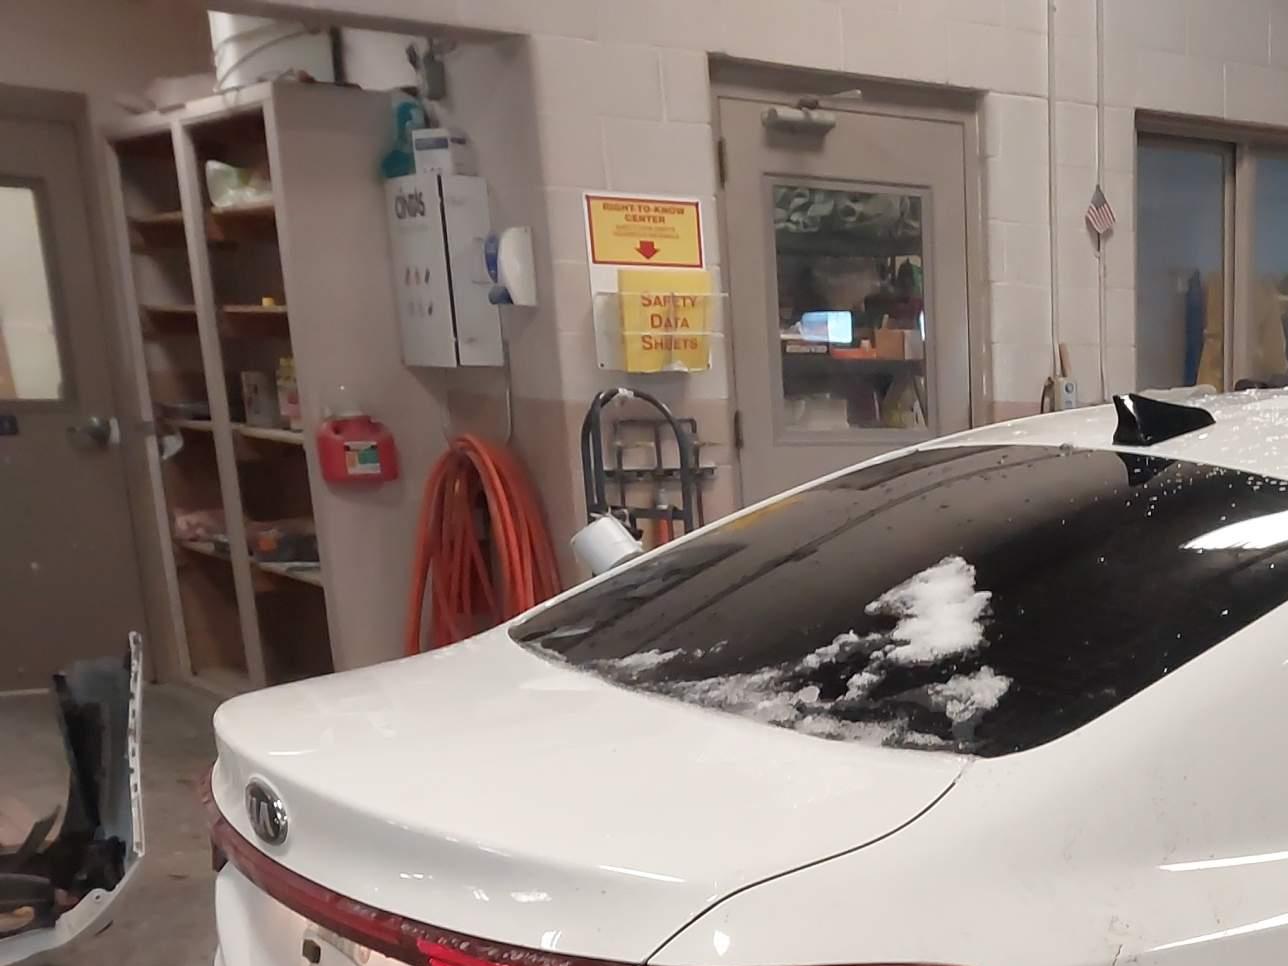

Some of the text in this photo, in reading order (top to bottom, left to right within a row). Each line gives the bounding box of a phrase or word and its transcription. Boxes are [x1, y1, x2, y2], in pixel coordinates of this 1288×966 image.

[624, 213, 666, 224] CENTER
[641, 293, 698, 308] SAFETY
[650, 313, 690, 329] DATA
[641, 334, 698, 351] SHEETS
